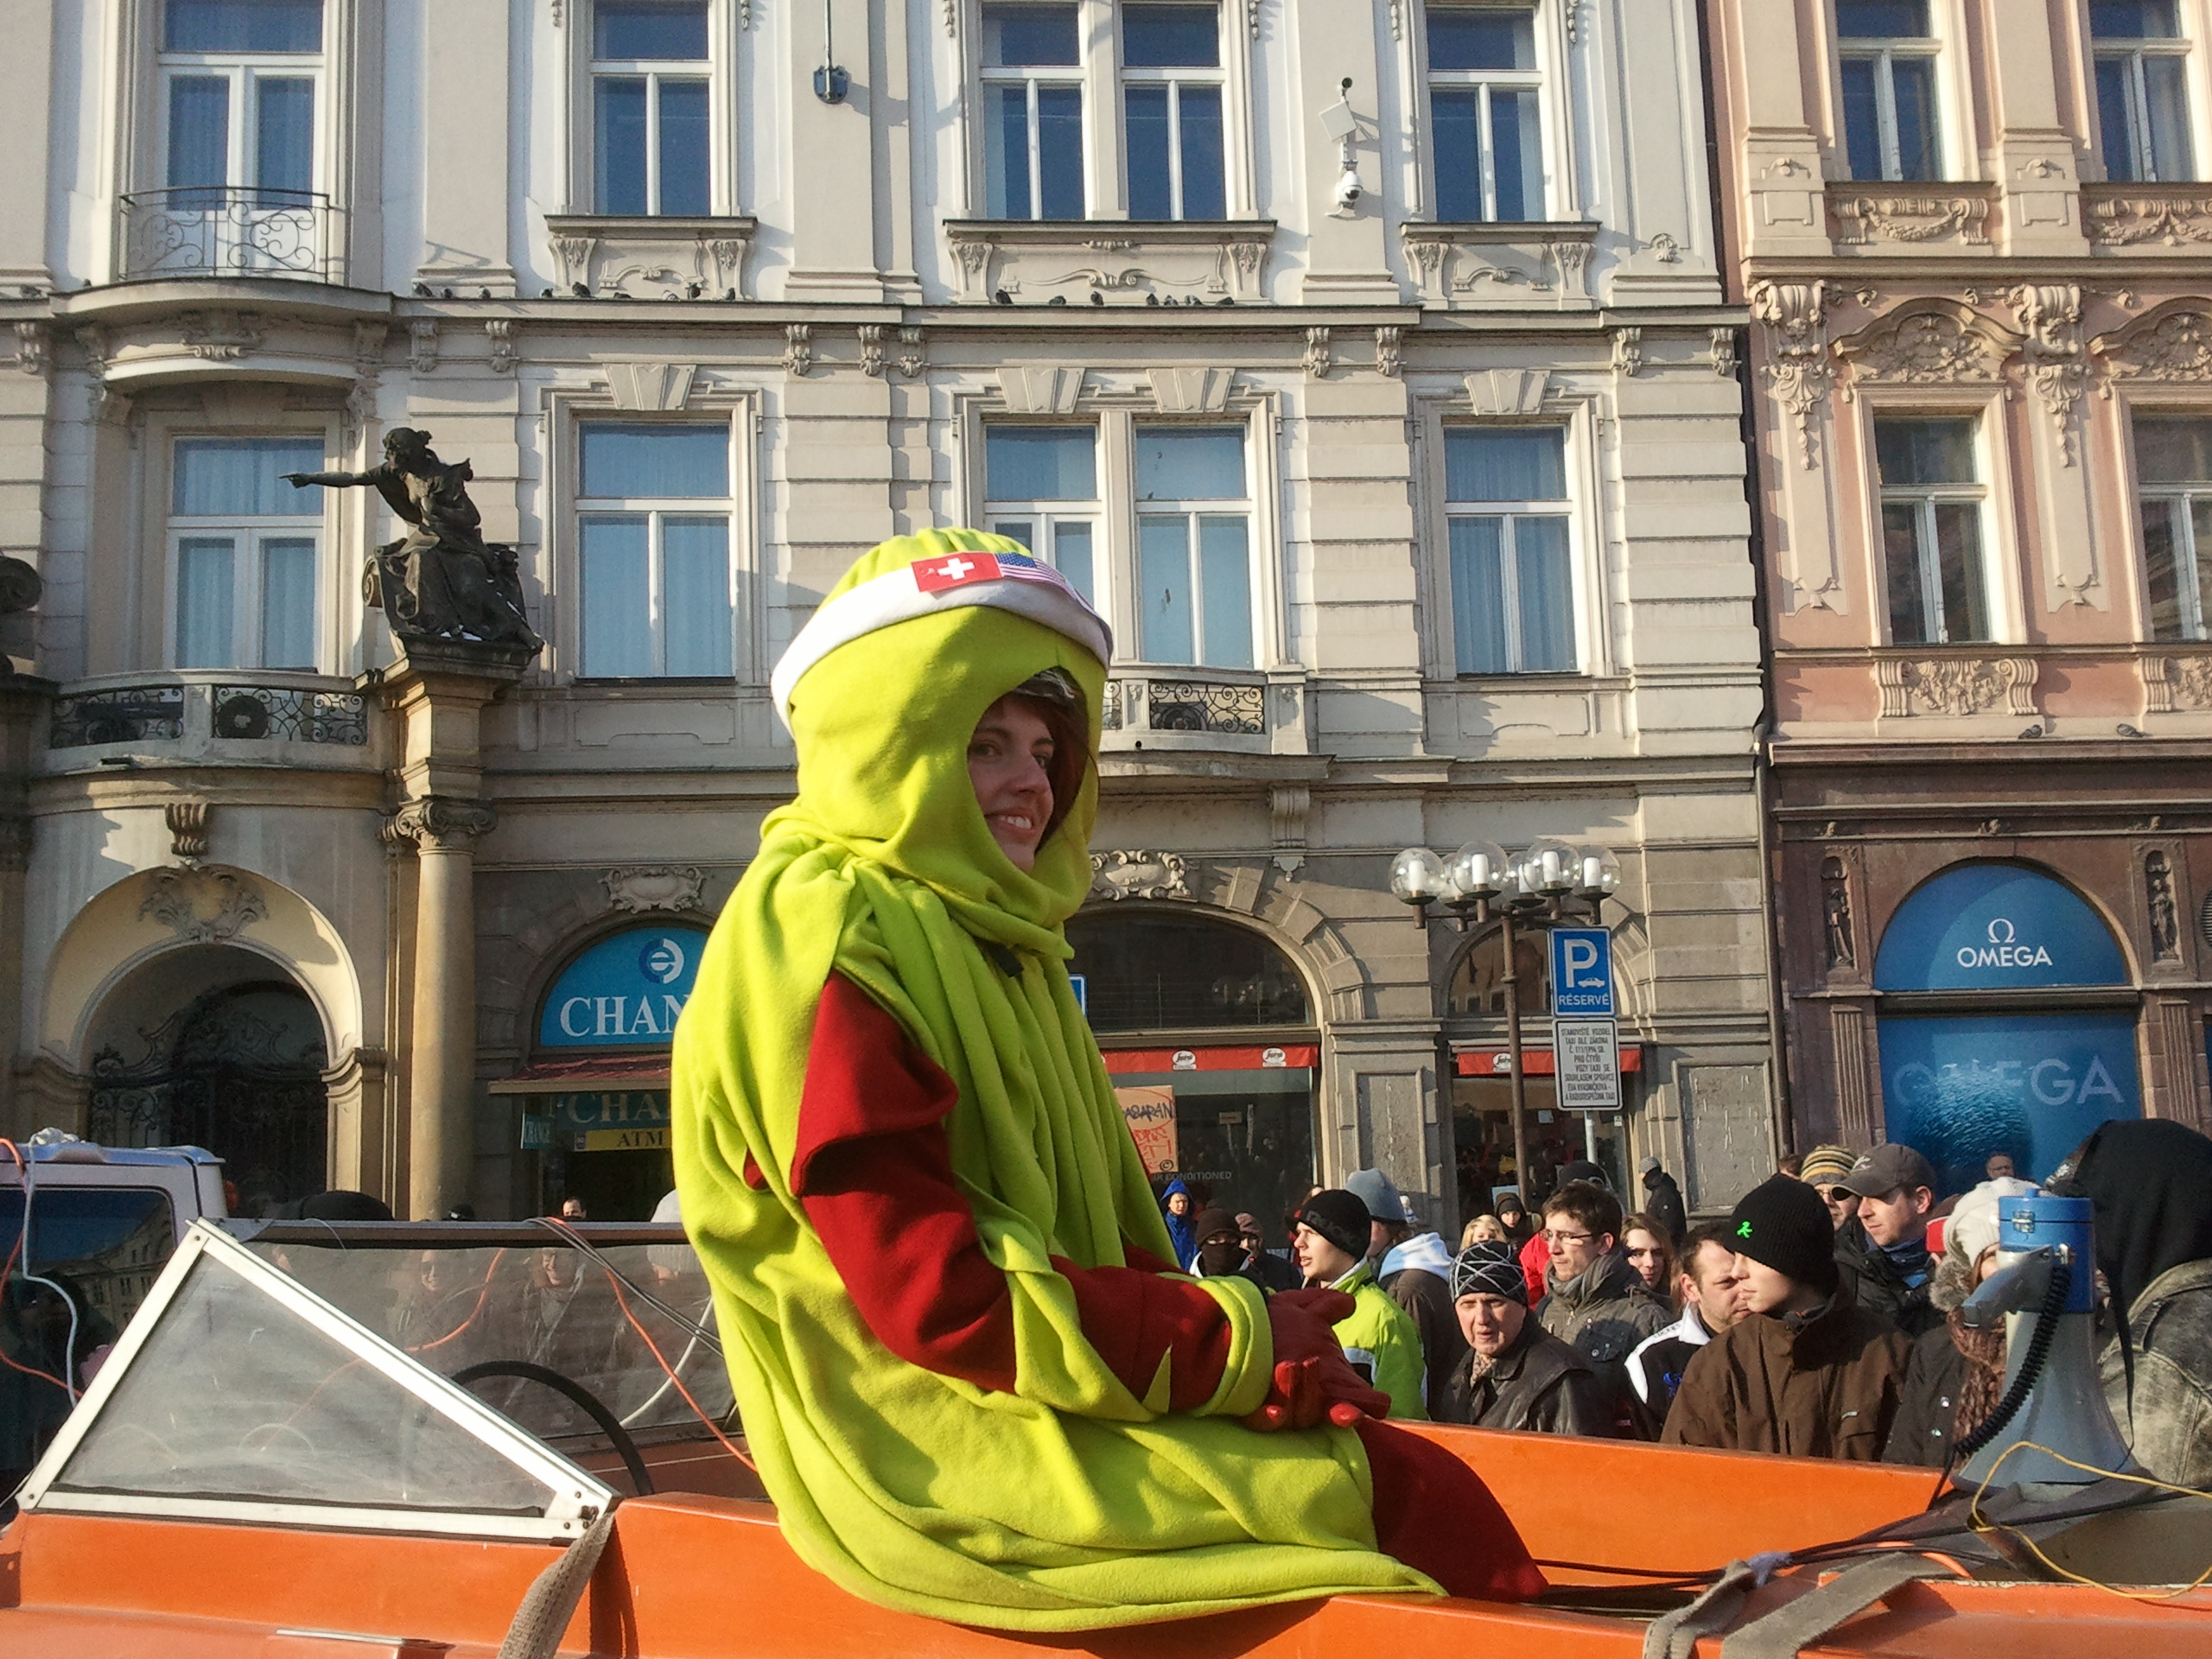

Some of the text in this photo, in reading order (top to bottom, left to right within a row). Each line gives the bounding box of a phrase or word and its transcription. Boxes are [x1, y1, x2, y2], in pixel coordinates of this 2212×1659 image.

[1564, 938, 1599, 988] P
[1957, 946, 2052, 968] OMEGA
[1558, 992, 1610, 1006] RÉSERVÉ
[568, 1093, 670, 1123] CHA
[617, 1130, 664, 1147] ATM
[1166, 1171, 1232, 1181] CONDITIONED
